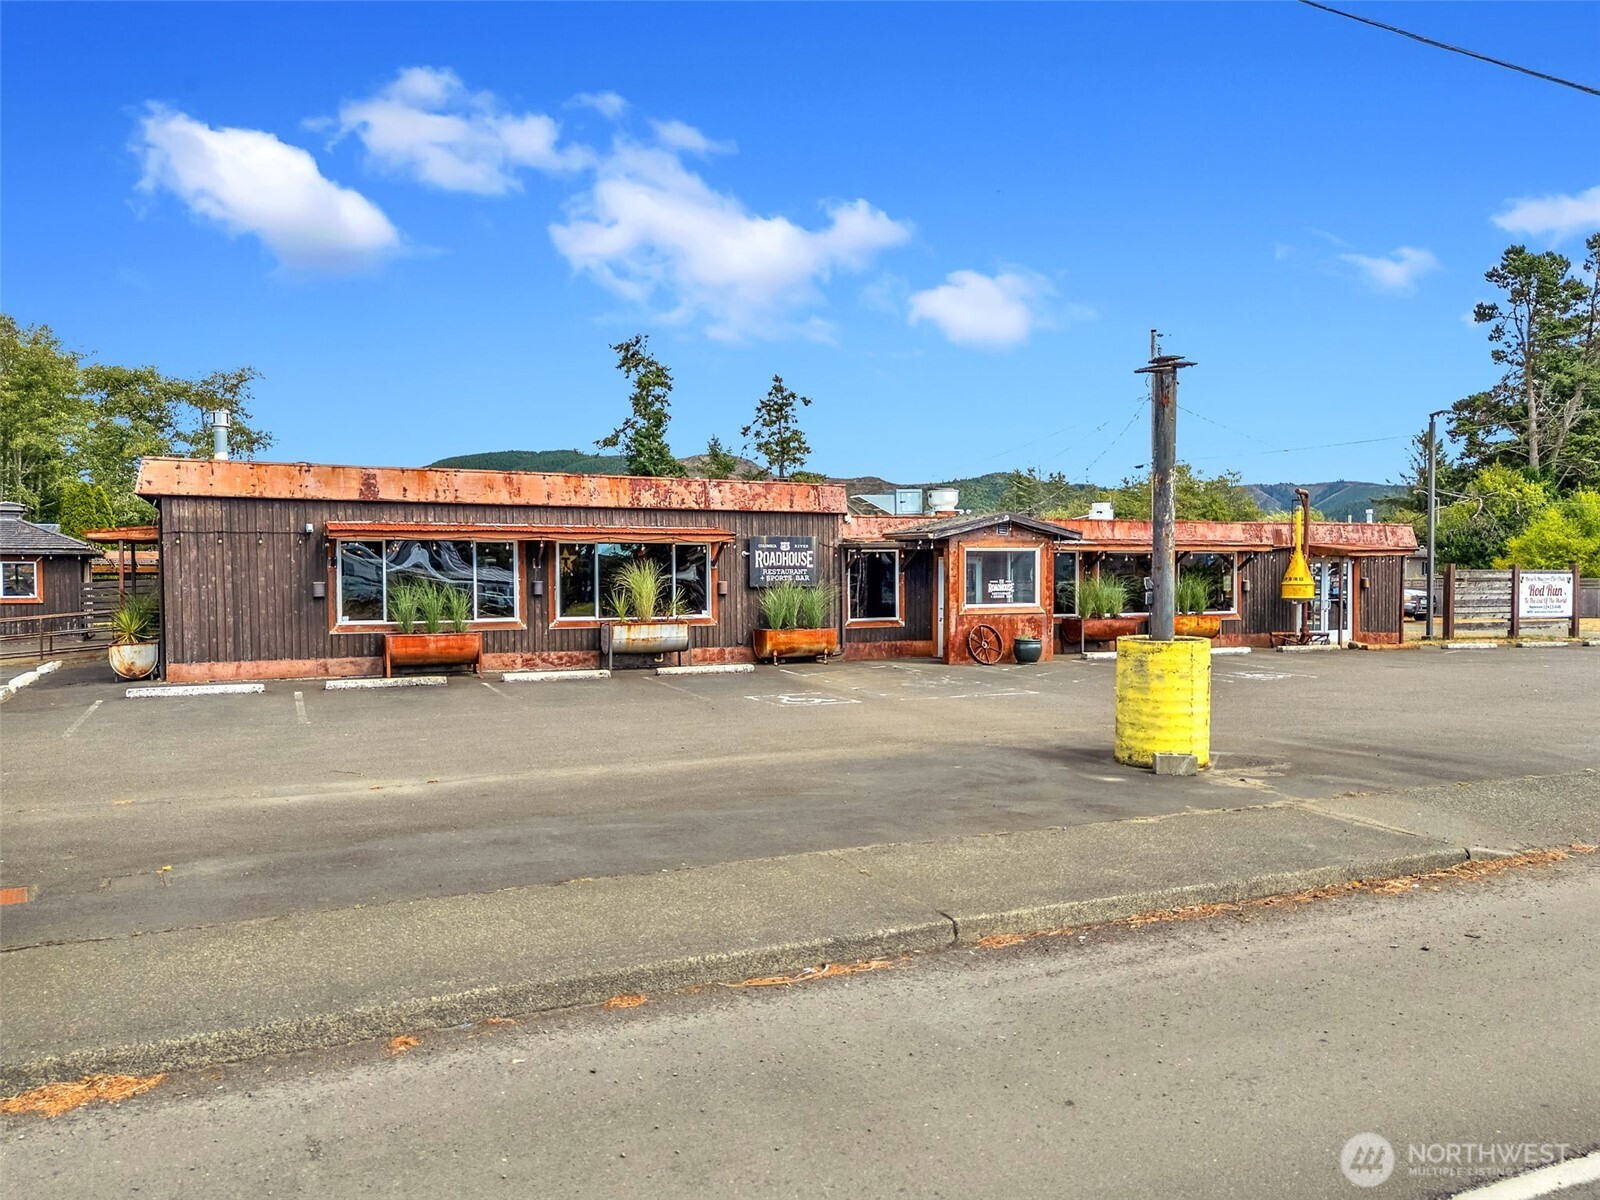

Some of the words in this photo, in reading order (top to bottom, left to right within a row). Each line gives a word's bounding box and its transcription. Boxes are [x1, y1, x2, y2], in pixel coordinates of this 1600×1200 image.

[755, 550, 814, 568] ROADHOUSE
[988, 583, 1015, 593] ROADHOUSE
[1528, 584, 1545, 597] Rod
[1546, 584, 1563, 597] Run
